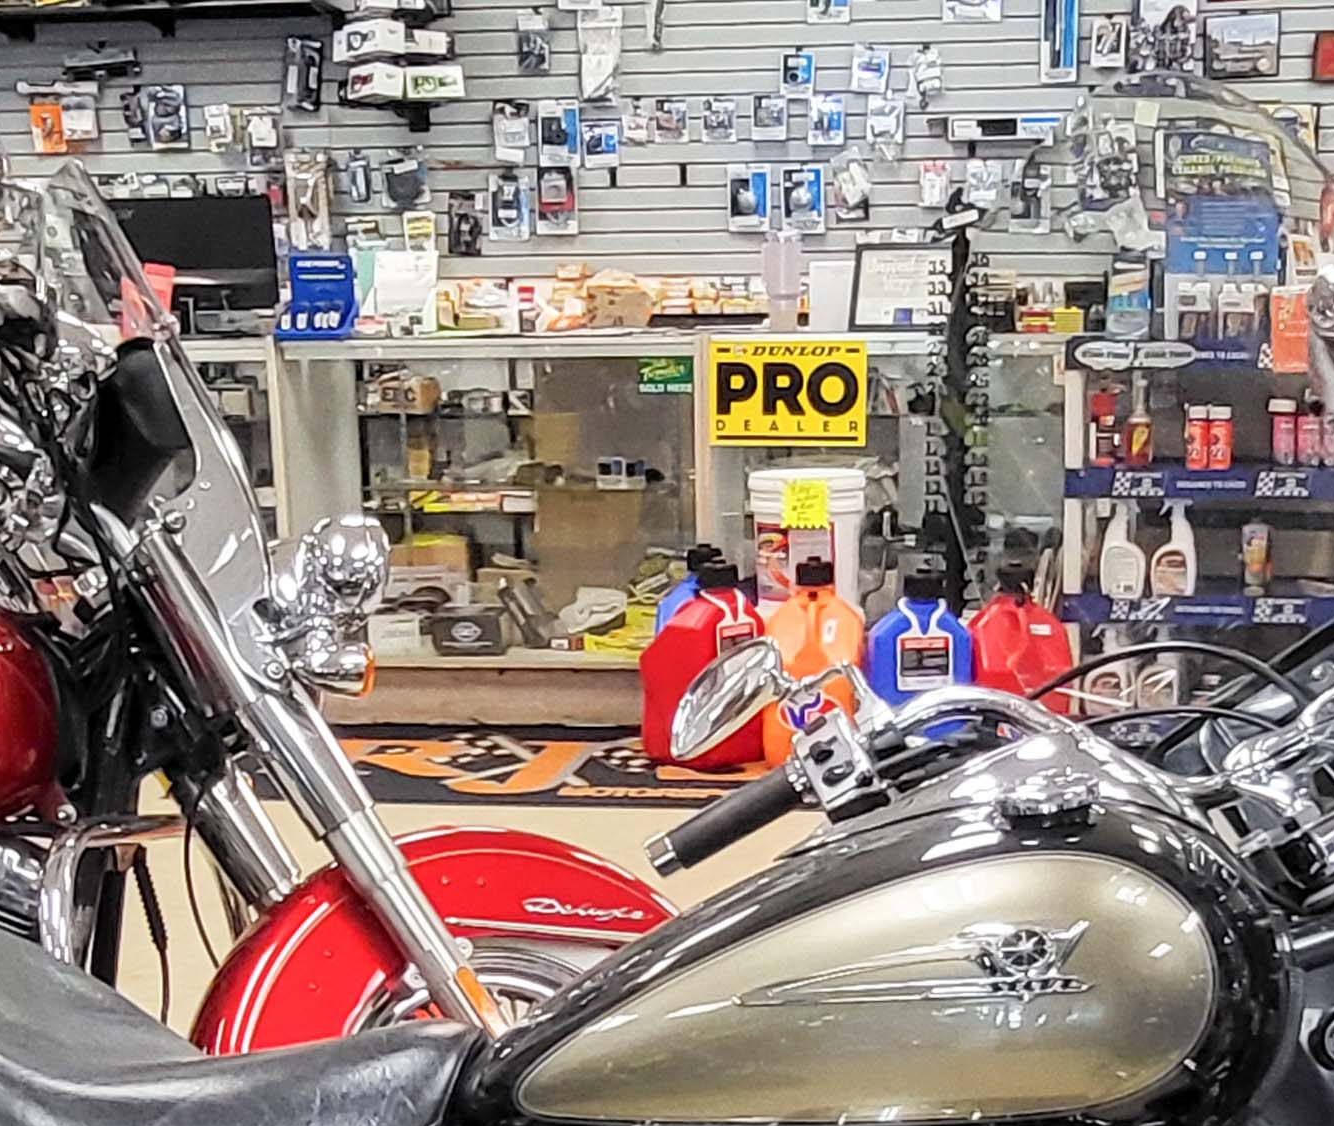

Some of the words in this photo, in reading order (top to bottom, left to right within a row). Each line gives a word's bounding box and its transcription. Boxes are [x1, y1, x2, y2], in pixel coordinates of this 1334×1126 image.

[750, 345, 842, 357] DUNLOP
[716, 361, 860, 418] PRO
[715, 419, 859, 432] DEALER
